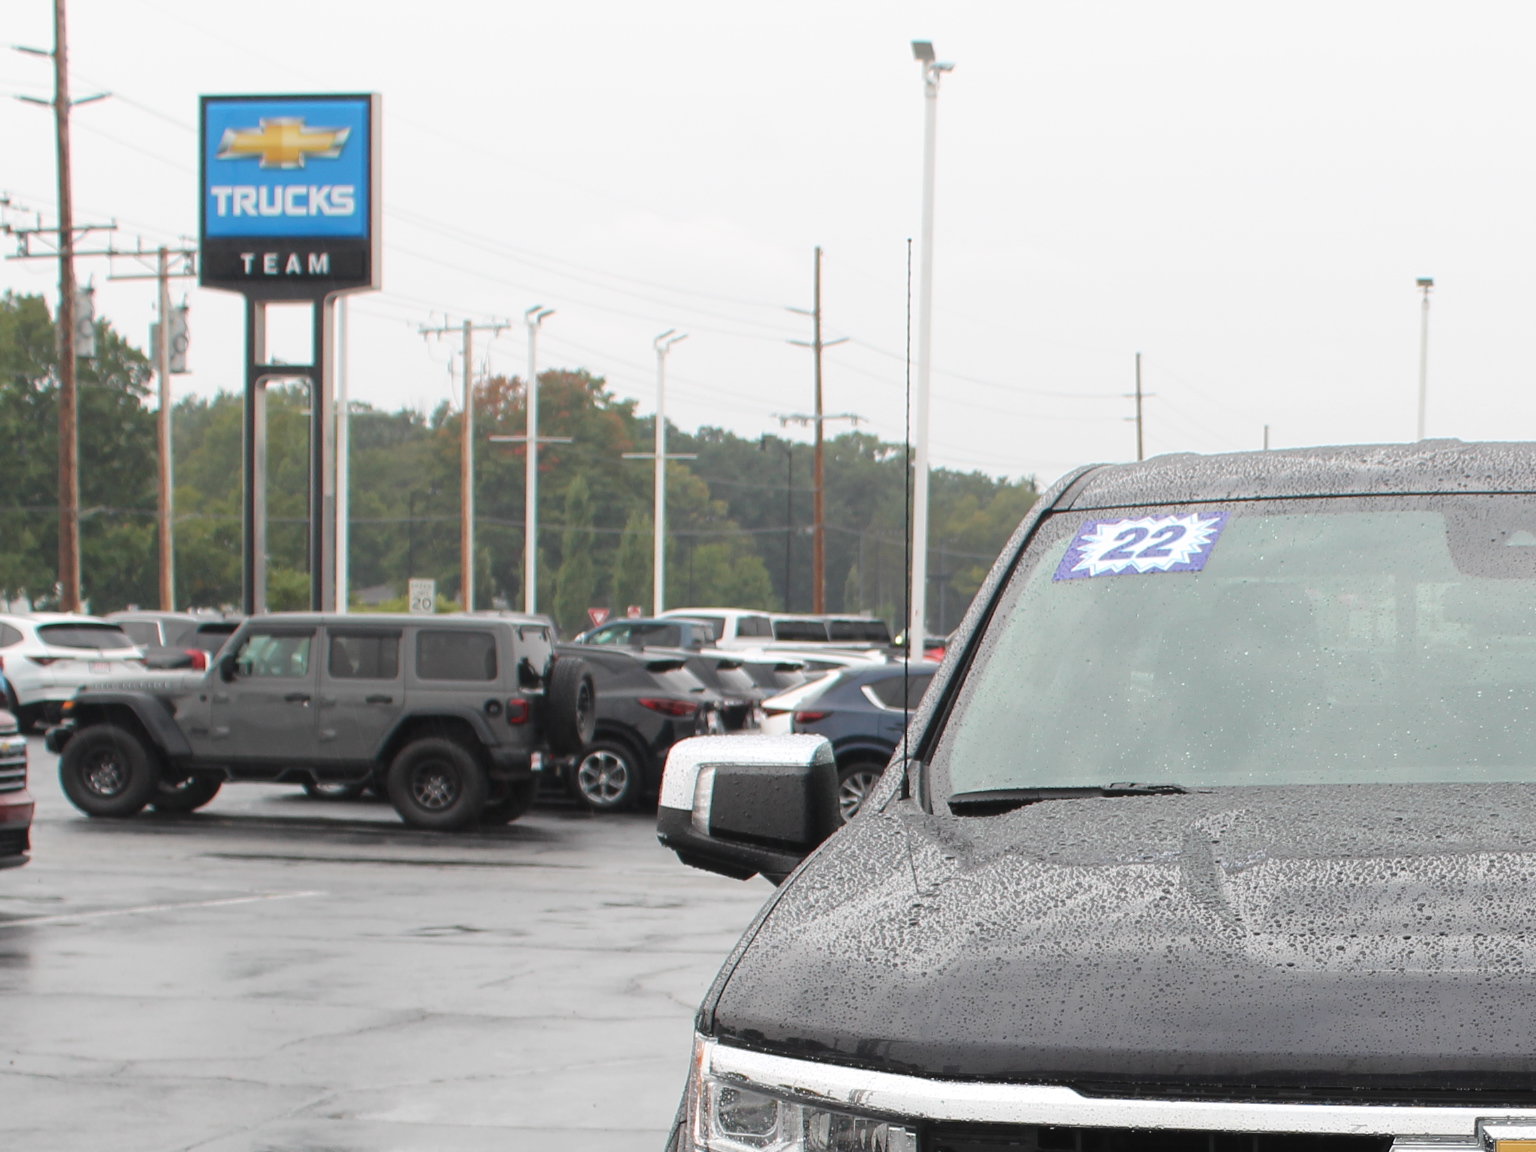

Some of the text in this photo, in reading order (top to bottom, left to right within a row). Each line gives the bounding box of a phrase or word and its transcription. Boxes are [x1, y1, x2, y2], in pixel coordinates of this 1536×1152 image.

[211, 184, 355, 217] TRUCKS
[240, 252, 330, 275] TEAM
[1098, 525, 1188, 561] 22
